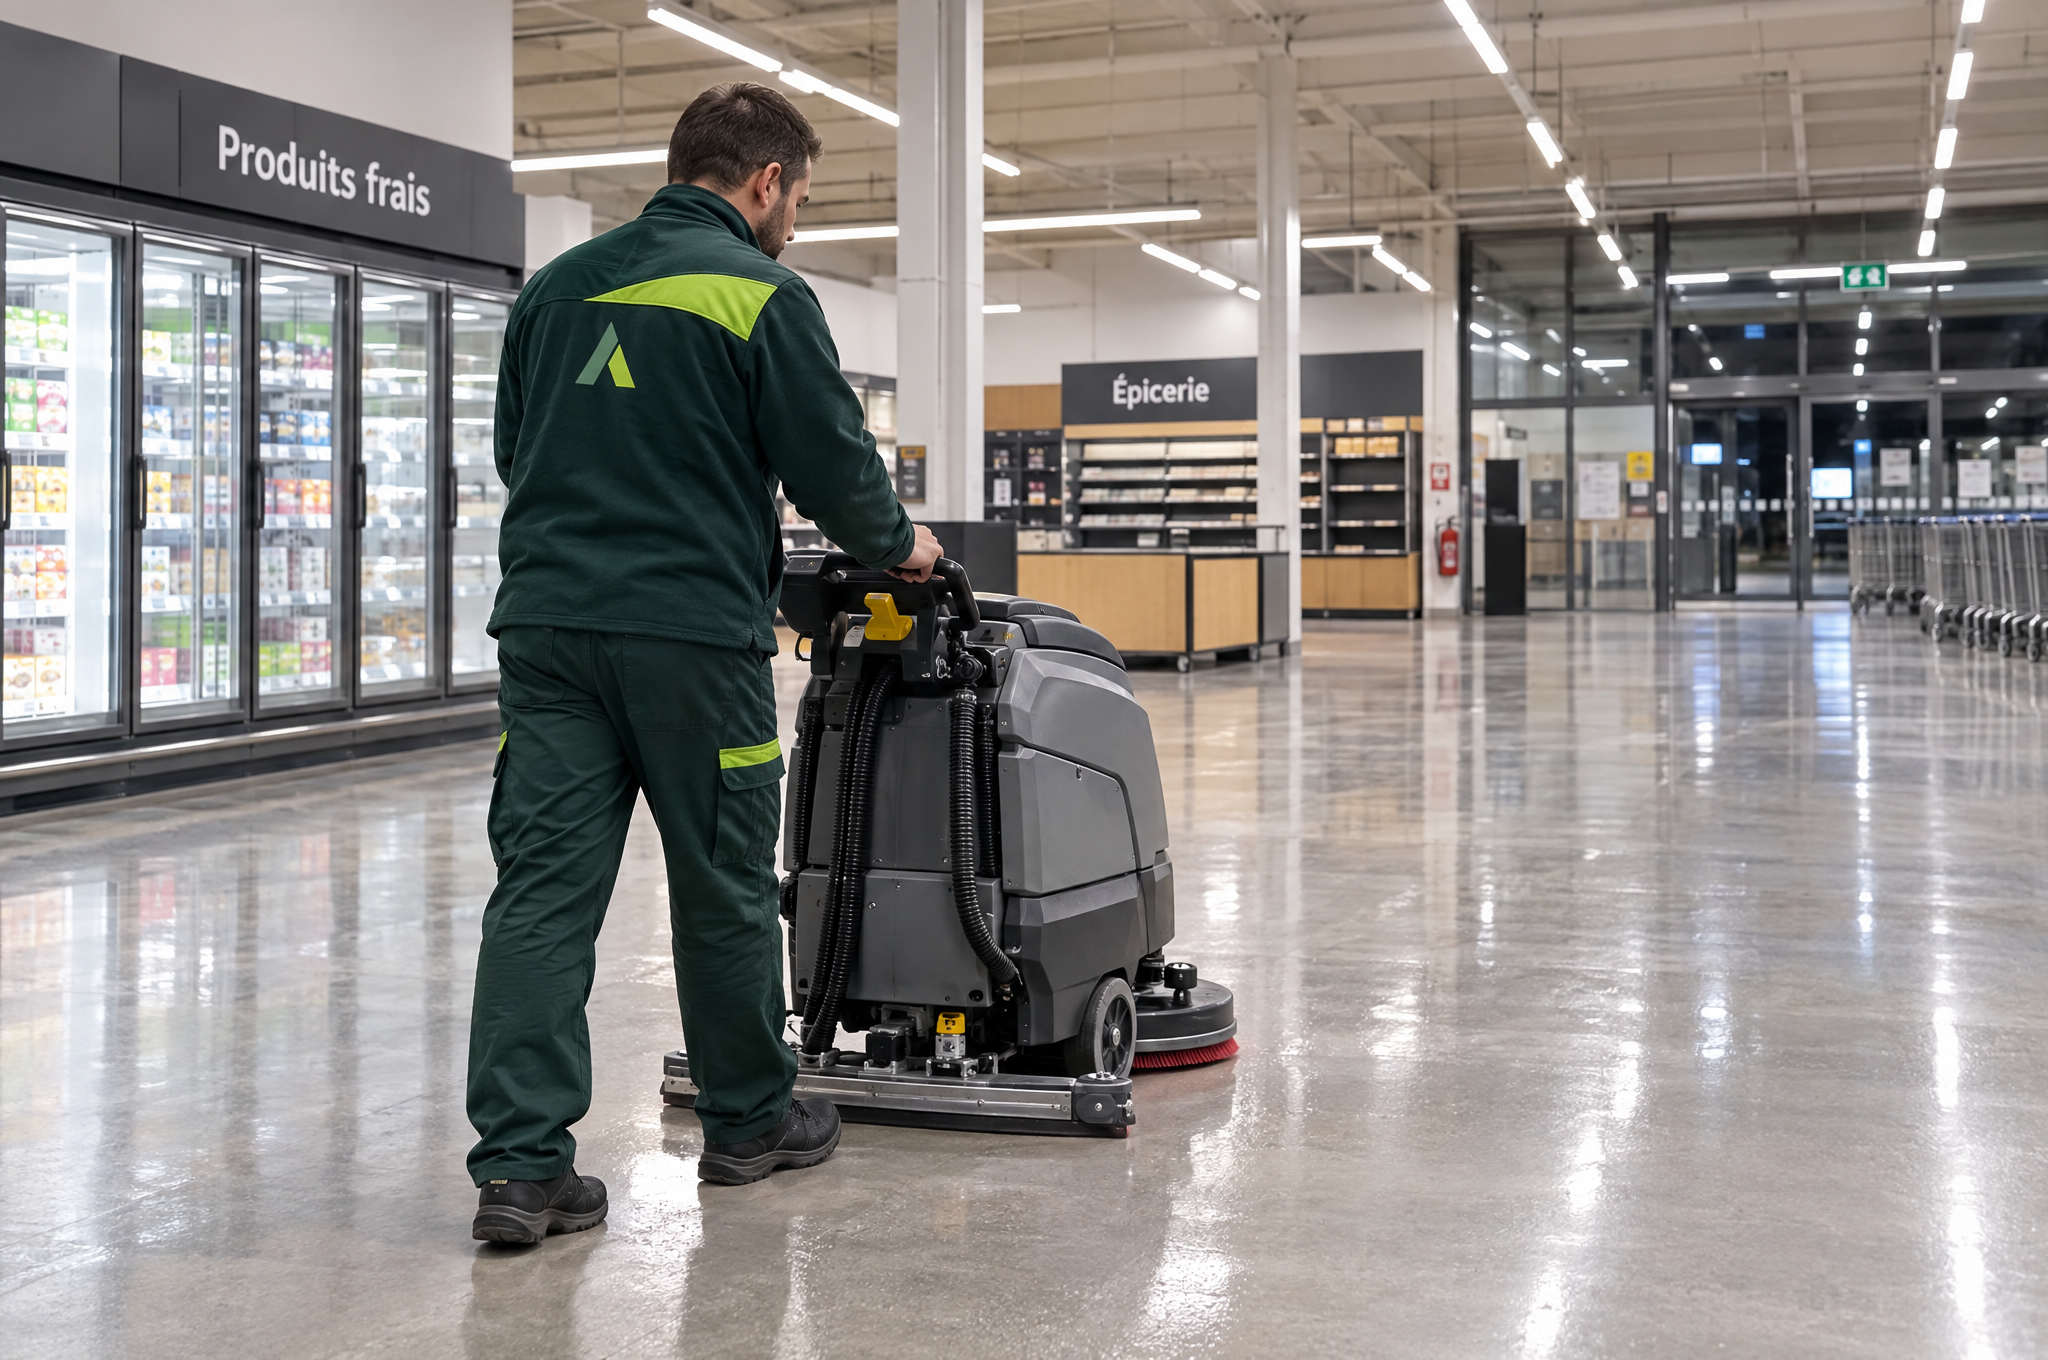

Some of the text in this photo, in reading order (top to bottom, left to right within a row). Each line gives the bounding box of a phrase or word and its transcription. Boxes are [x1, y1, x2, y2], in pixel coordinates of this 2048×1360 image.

[218, 124, 431, 217] Produits frais
[1112, 372, 1211, 411] Épicerie
